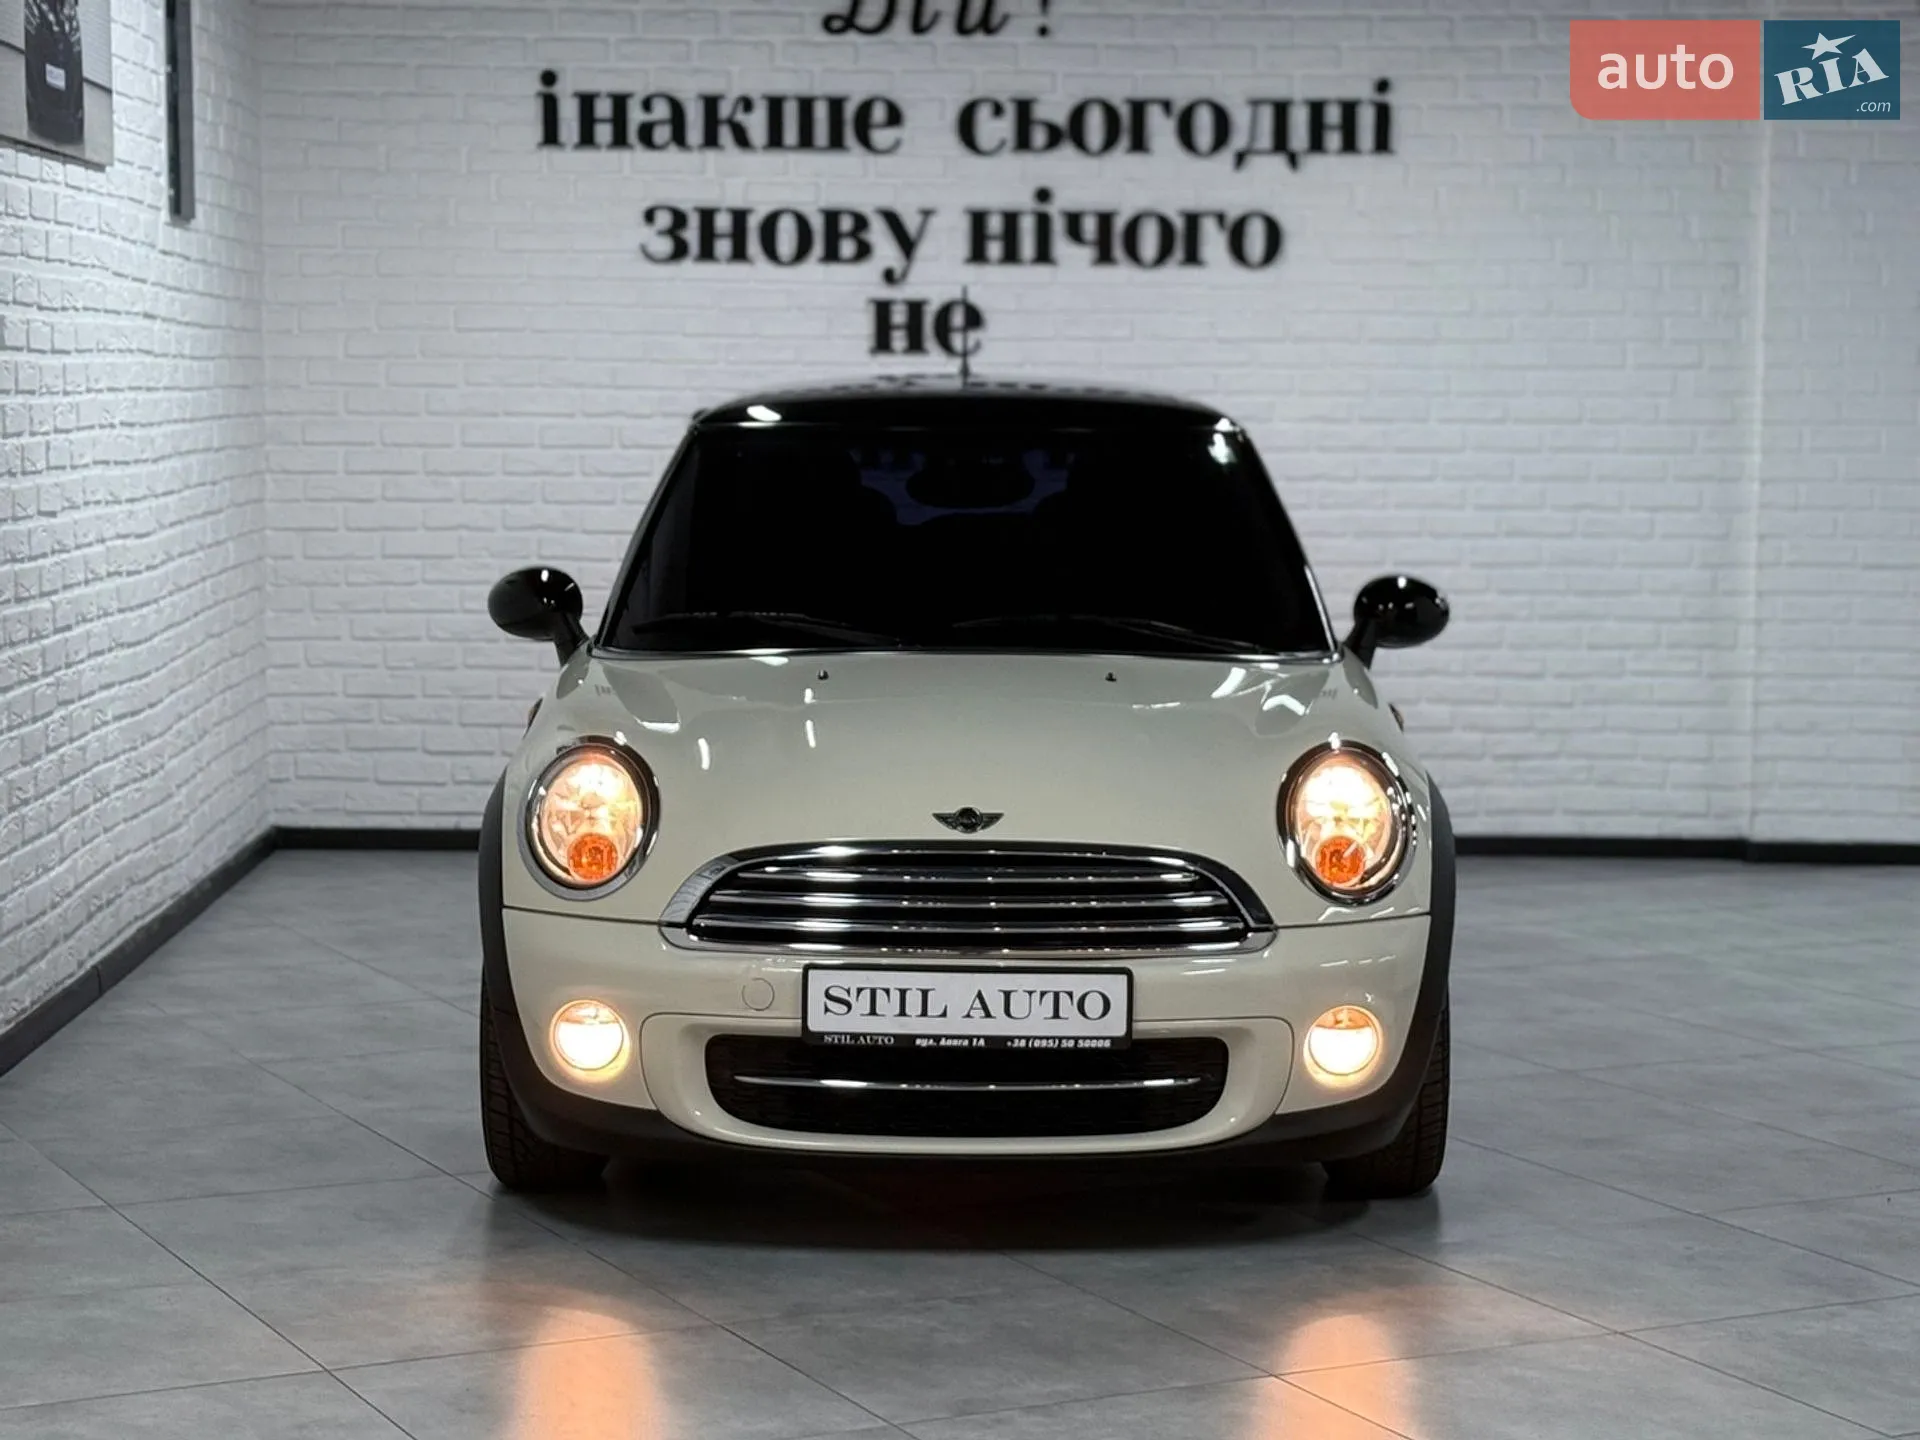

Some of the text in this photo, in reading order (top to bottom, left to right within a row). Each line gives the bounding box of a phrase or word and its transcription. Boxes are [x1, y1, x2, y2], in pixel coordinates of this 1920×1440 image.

[536, 69, 1396, 172] інакше сьогодні
[641, 187, 1284, 287] знову нічого
[869, 296, 986, 357] не
[823, 985, 1112, 1021] STIL AUTO
[823, 1034, 895, 1047] STIL AUTO
